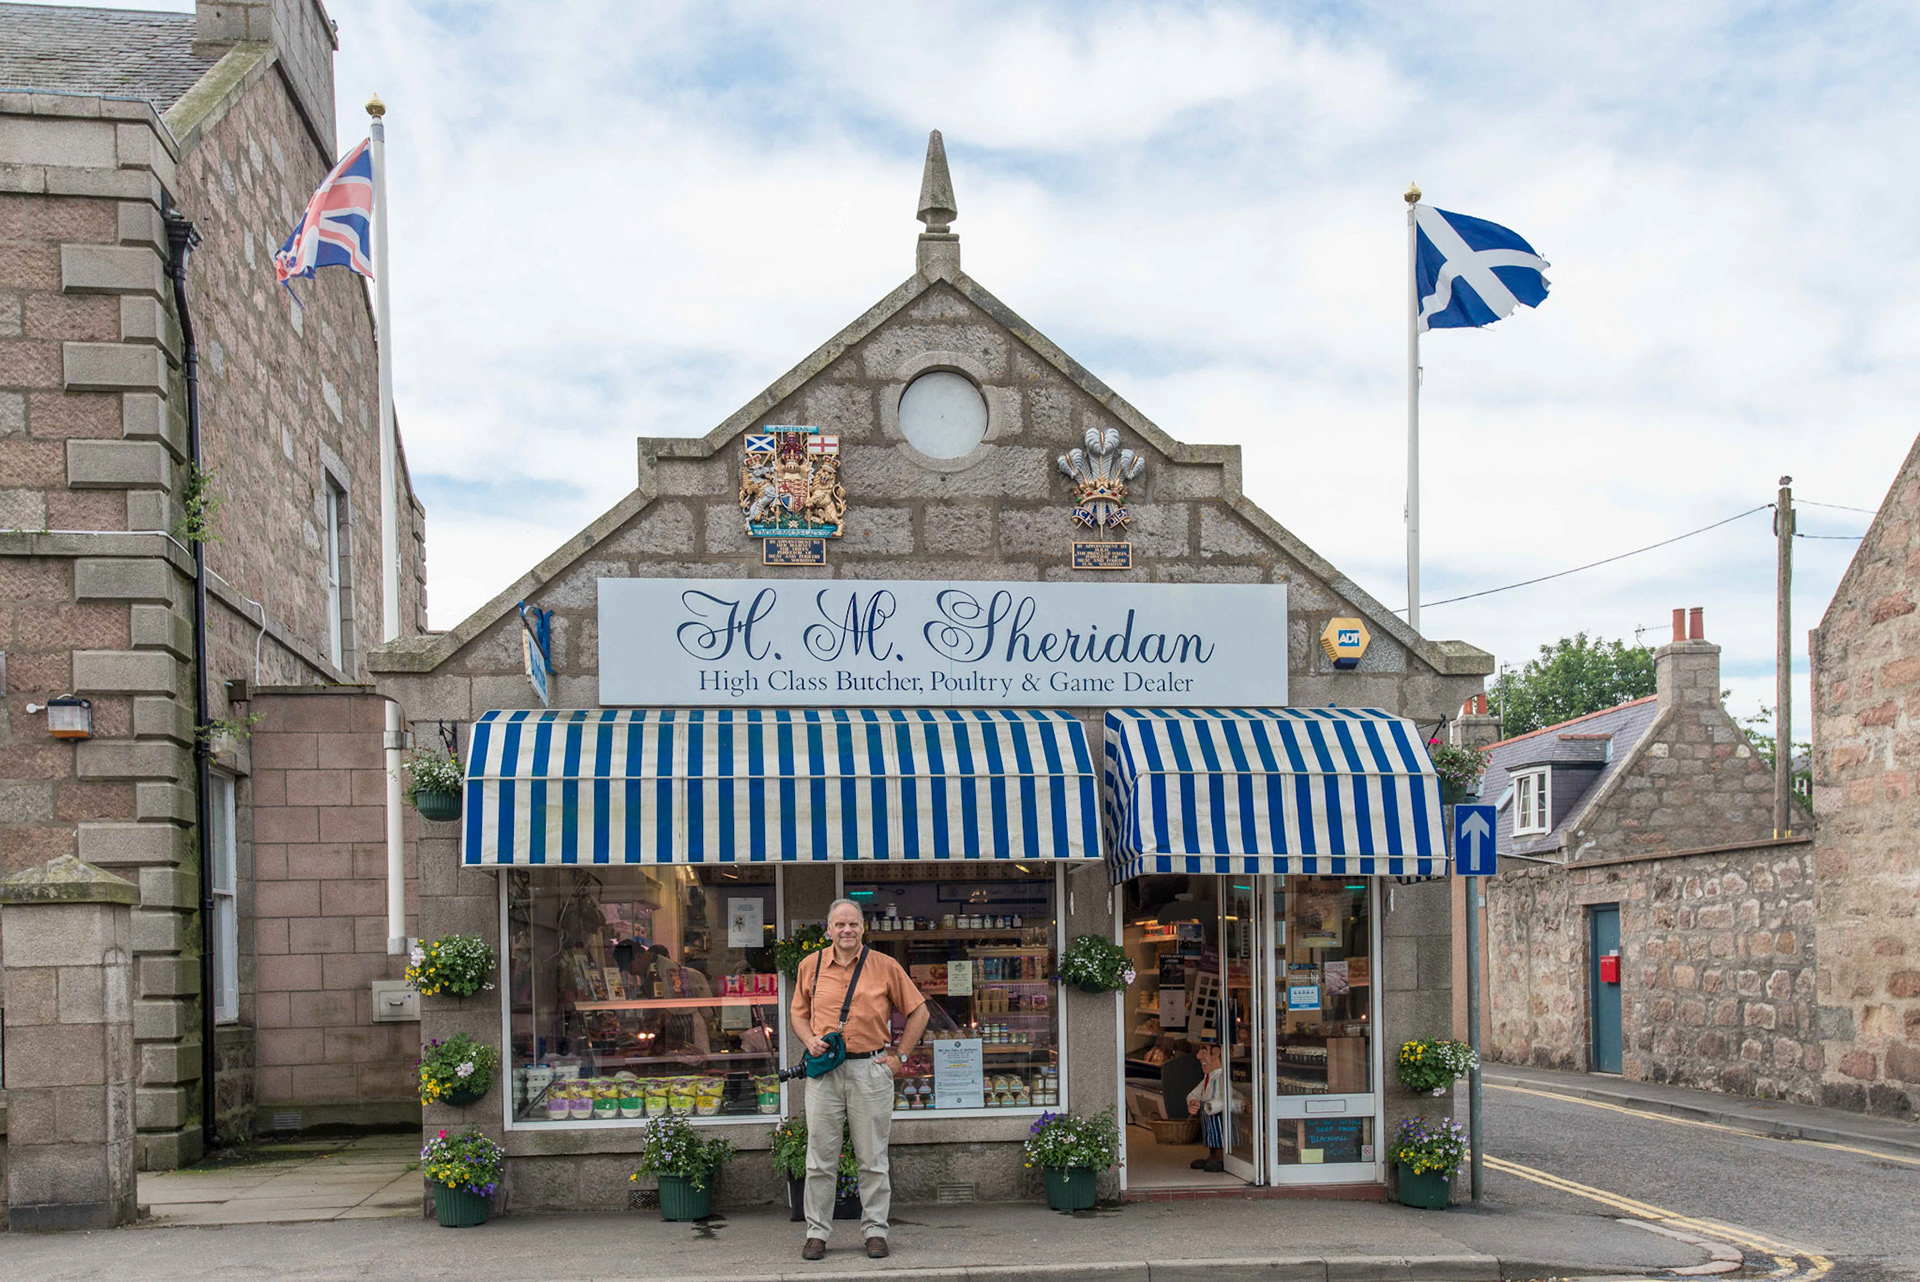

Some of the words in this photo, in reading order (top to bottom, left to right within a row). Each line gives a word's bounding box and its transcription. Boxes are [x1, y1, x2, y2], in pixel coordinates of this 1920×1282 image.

[1075, 508, 1094, 525] ICH
[677, 588, 782, 661] H.
[803, 588, 904, 662] M.
[923, 590, 1214, 664] Sheridan
[1338, 632, 1360, 644] ADT
[699, 670, 759, 698] High
[768, 670, 828, 691] Class
[836, 670, 924, 694] Butcher,
[930, 671, 1013, 698] Poultry
[1021, 672, 1042, 692] &
[1050, 671, 1115, 692] Game
[1123, 671, 1194, 692] Dealer
